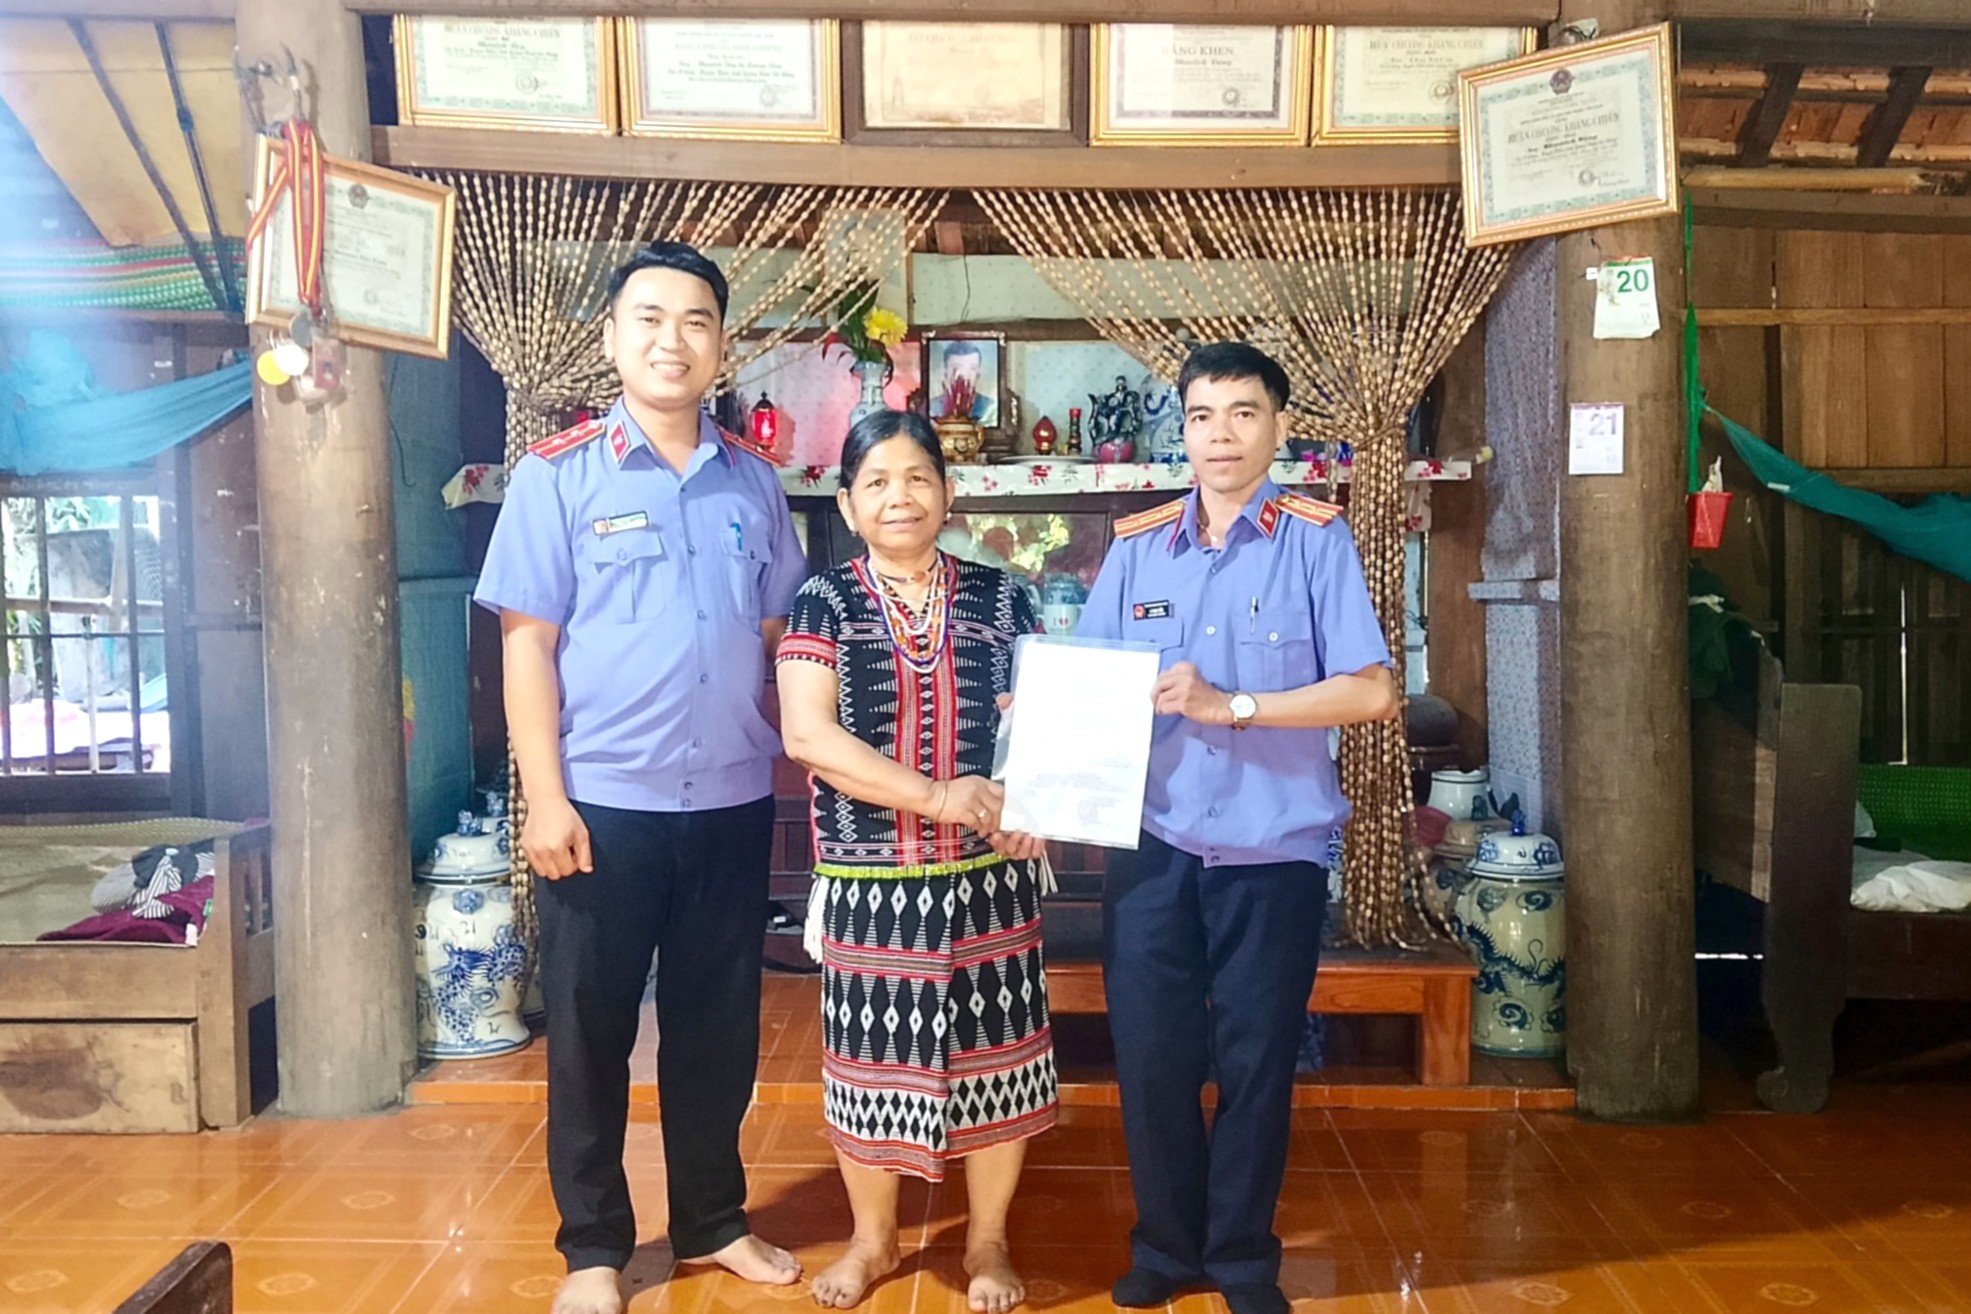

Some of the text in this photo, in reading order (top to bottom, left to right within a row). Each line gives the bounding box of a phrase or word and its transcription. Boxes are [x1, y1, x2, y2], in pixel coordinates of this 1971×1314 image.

[1199, 46, 1234, 56] KHEN
[1617, 268, 1650, 293] 20
[1589, 412, 1617, 436] 21
